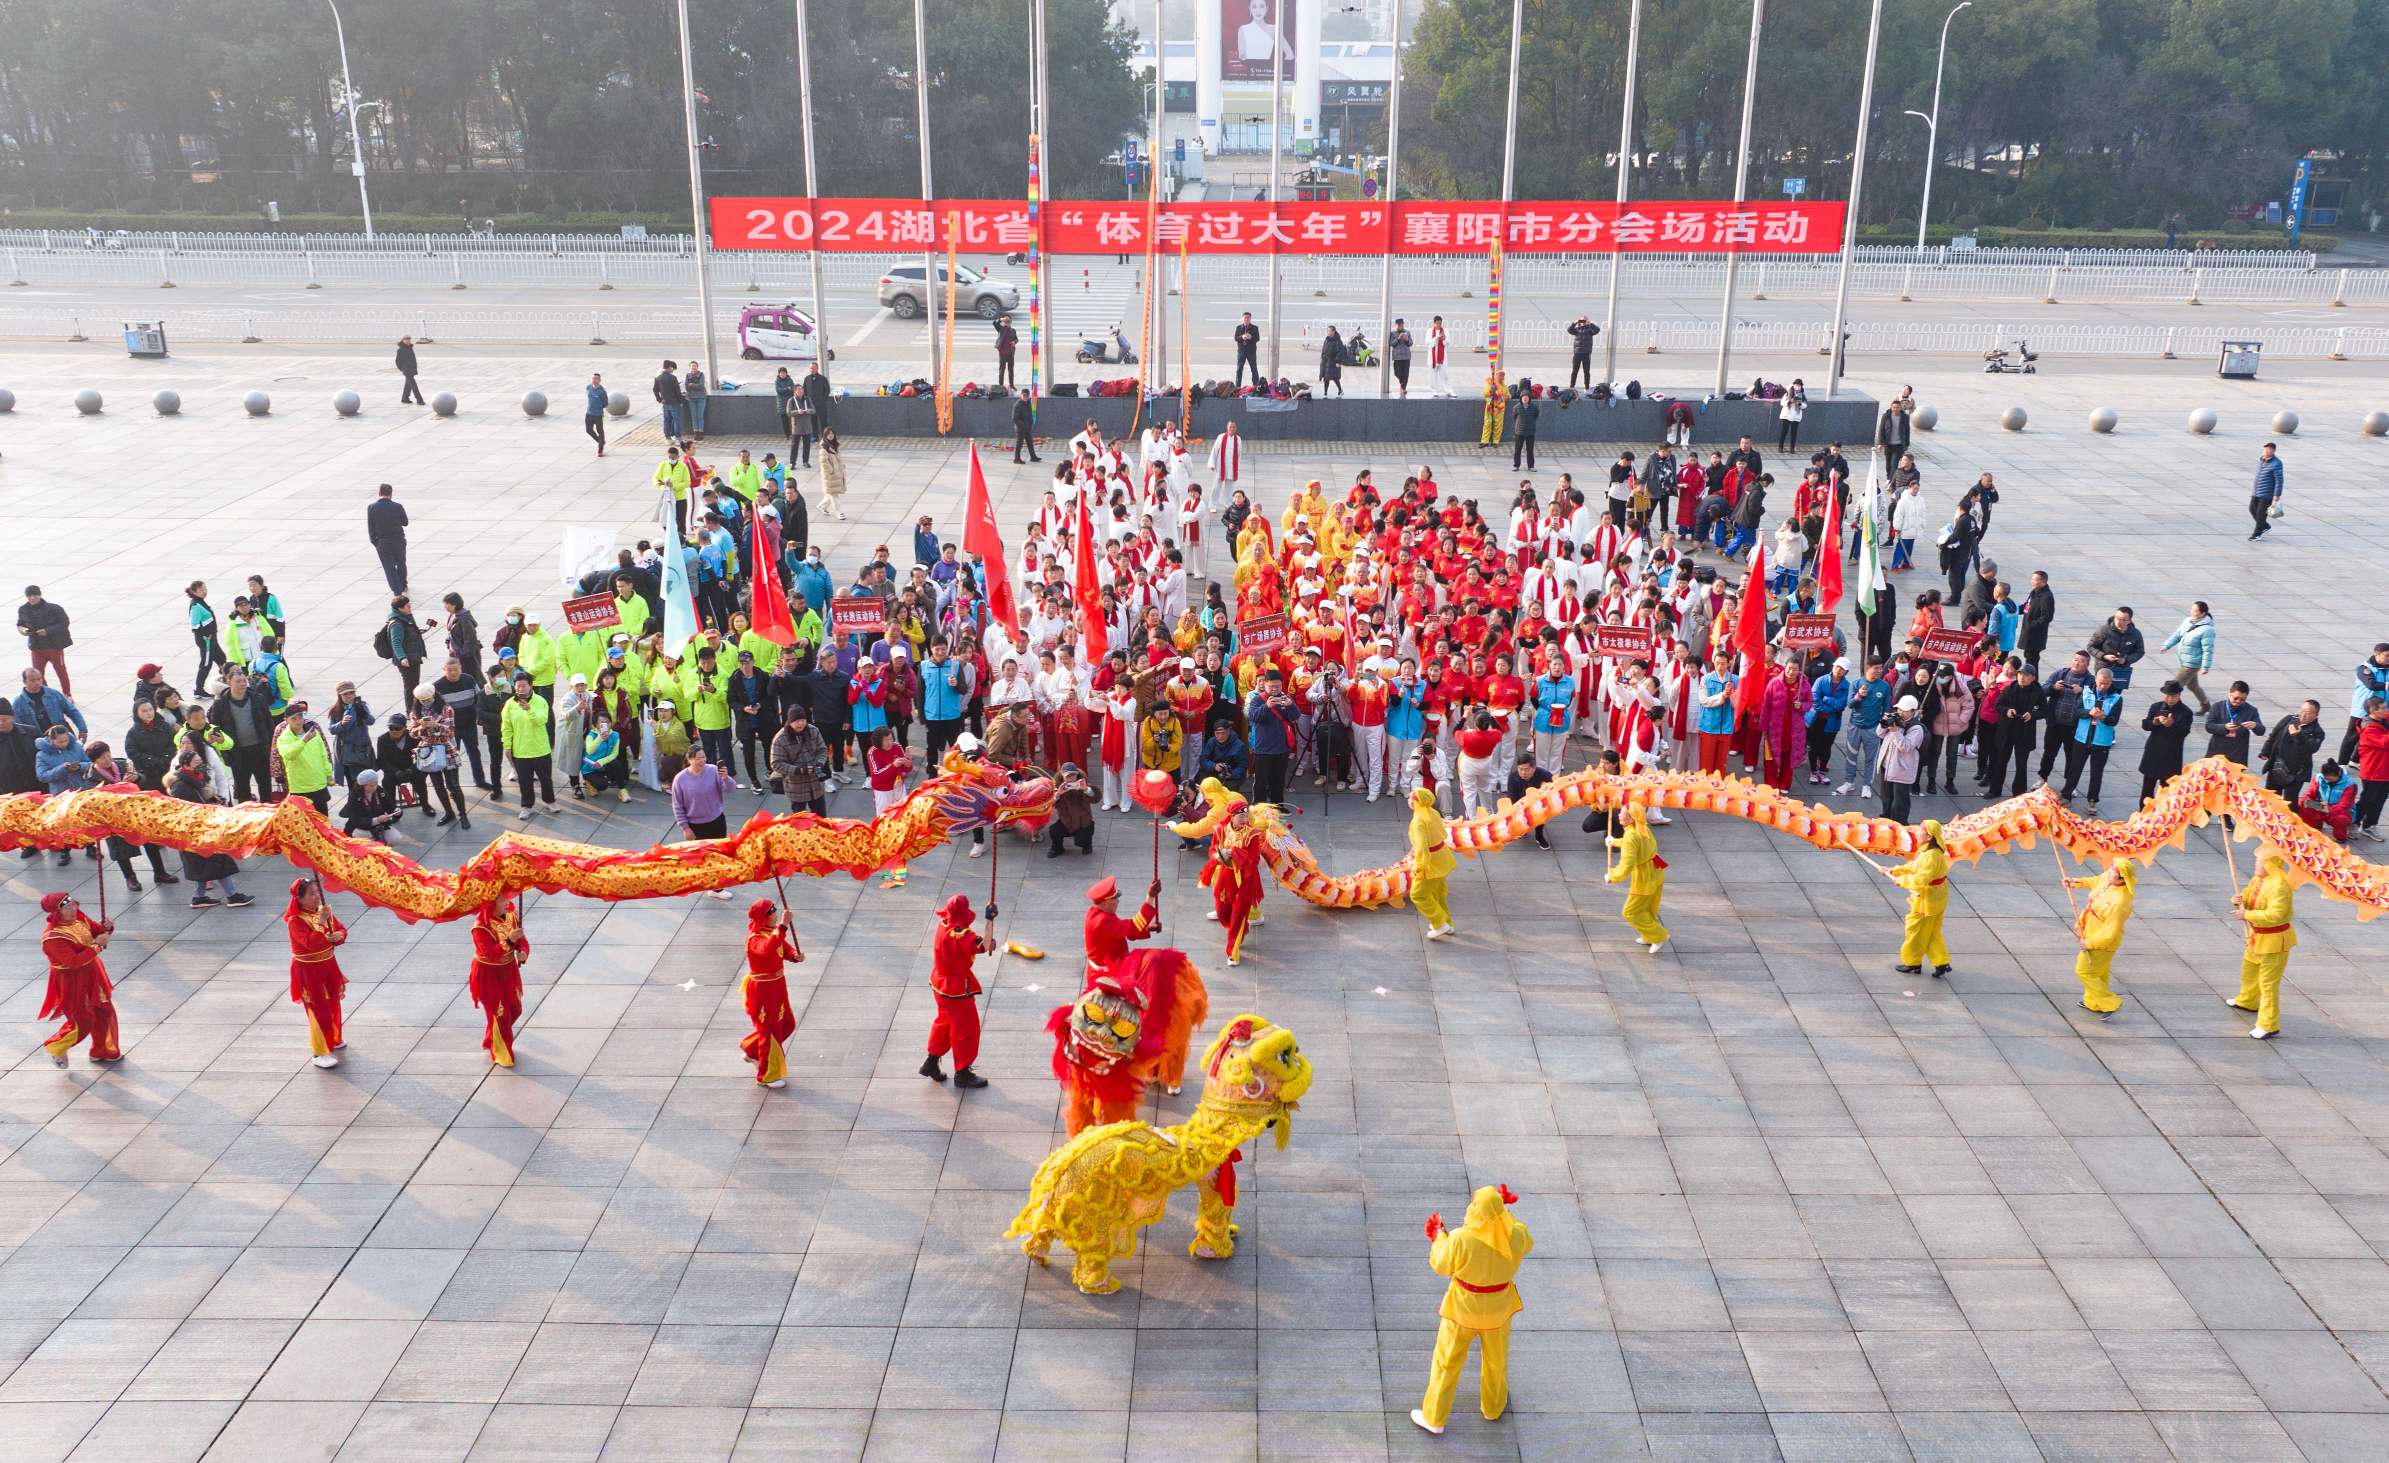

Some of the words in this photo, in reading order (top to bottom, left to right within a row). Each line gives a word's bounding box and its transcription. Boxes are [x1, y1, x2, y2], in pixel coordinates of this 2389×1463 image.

[1243, 627, 1283, 645] 市广场舞协会
[1788, 626, 1830, 638] 市武术协会
[1601, 637, 1647, 650] 市太极拳协会
[1927, 640, 1968, 653] 市户外运动协会
